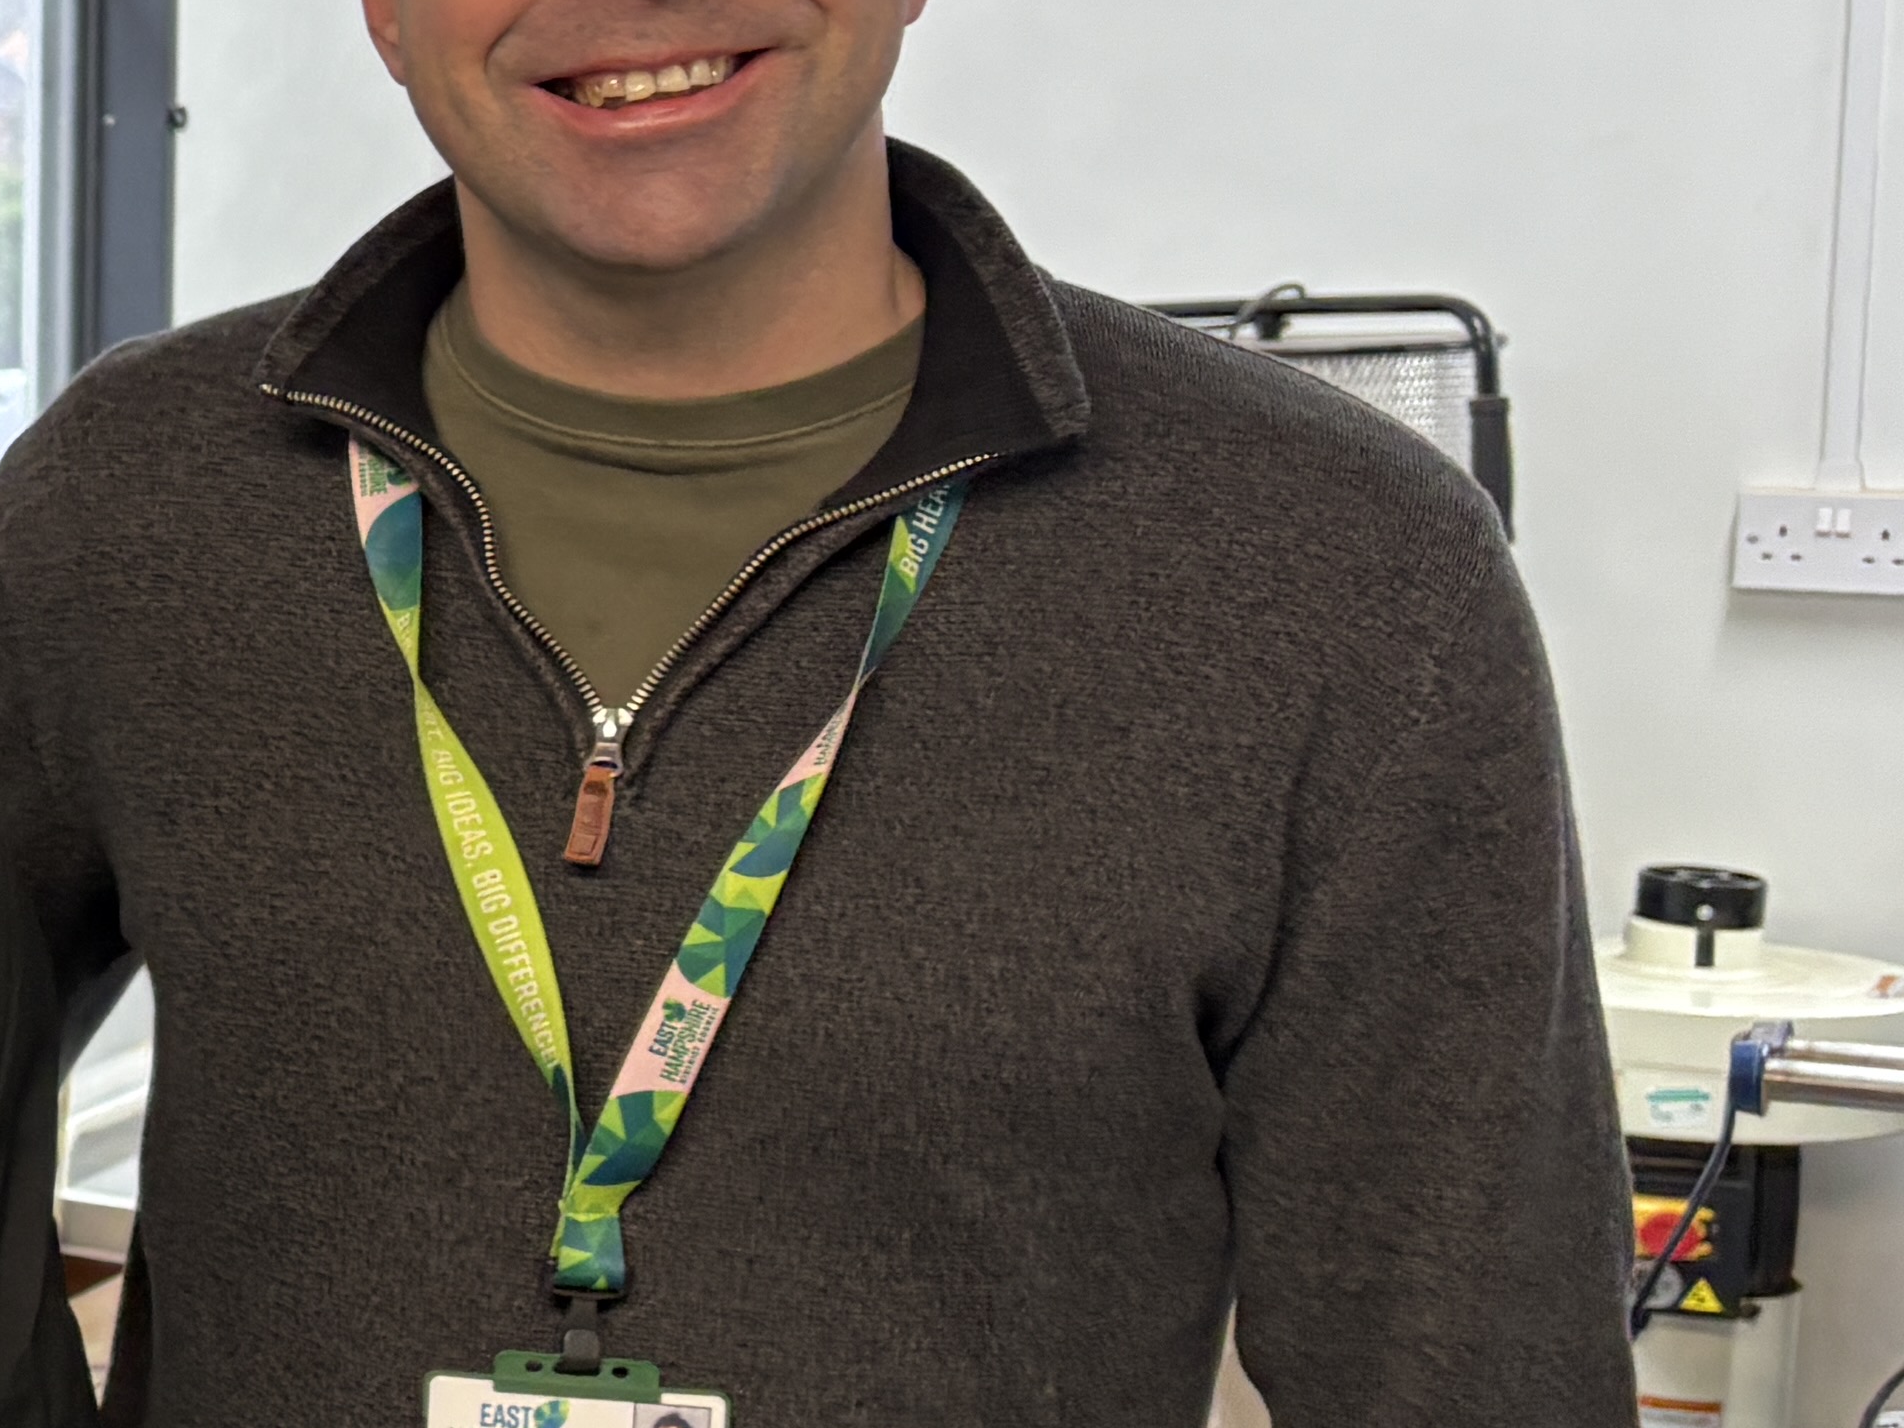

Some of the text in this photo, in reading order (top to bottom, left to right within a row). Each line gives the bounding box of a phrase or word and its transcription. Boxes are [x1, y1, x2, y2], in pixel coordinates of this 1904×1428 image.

[900, 484, 951, 579] BIG HEA
[471, 868, 513, 914] BIG
[648, 1019, 679, 1057] EAST
[659, 999, 711, 1083] HAMPSHIRE
